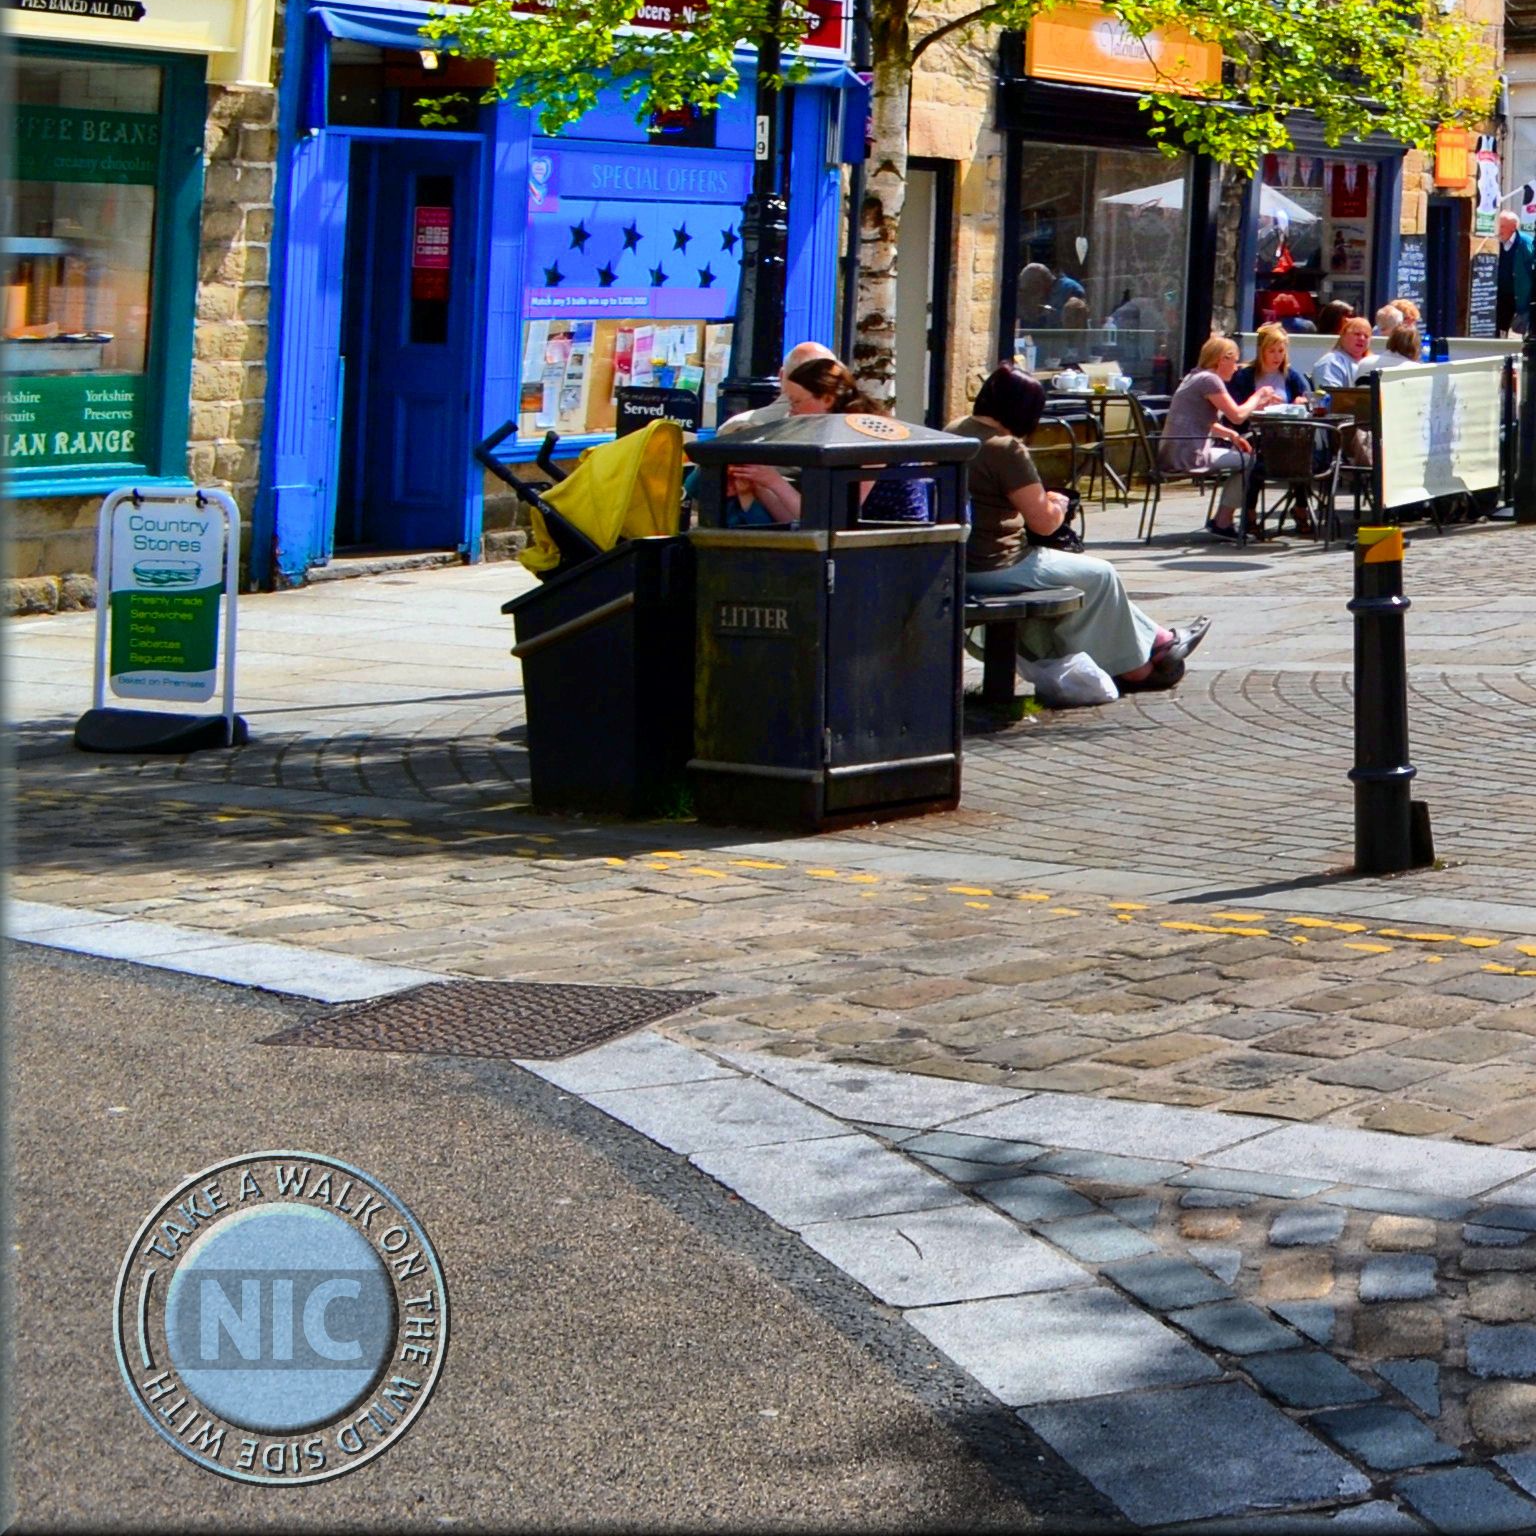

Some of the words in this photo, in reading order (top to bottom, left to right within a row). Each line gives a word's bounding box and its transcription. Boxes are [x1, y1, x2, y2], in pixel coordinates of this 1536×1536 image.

[90, 2, 110, 17] ALL
[112, 5, 136, 19] DAY
[592, 163, 660, 192] SPECIAL
[667, 167, 729, 195] OFFERS
[85, 389, 135, 403] Yorkshire
[83, 407, 134, 421] Preserves
[623, 402, 665, 416] Served
[53, 429, 136, 455] RANGE
[129, 515, 209, 537] Country
[133, 535, 202, 553] Stores
[721, 606, 789, 630] LITTER
